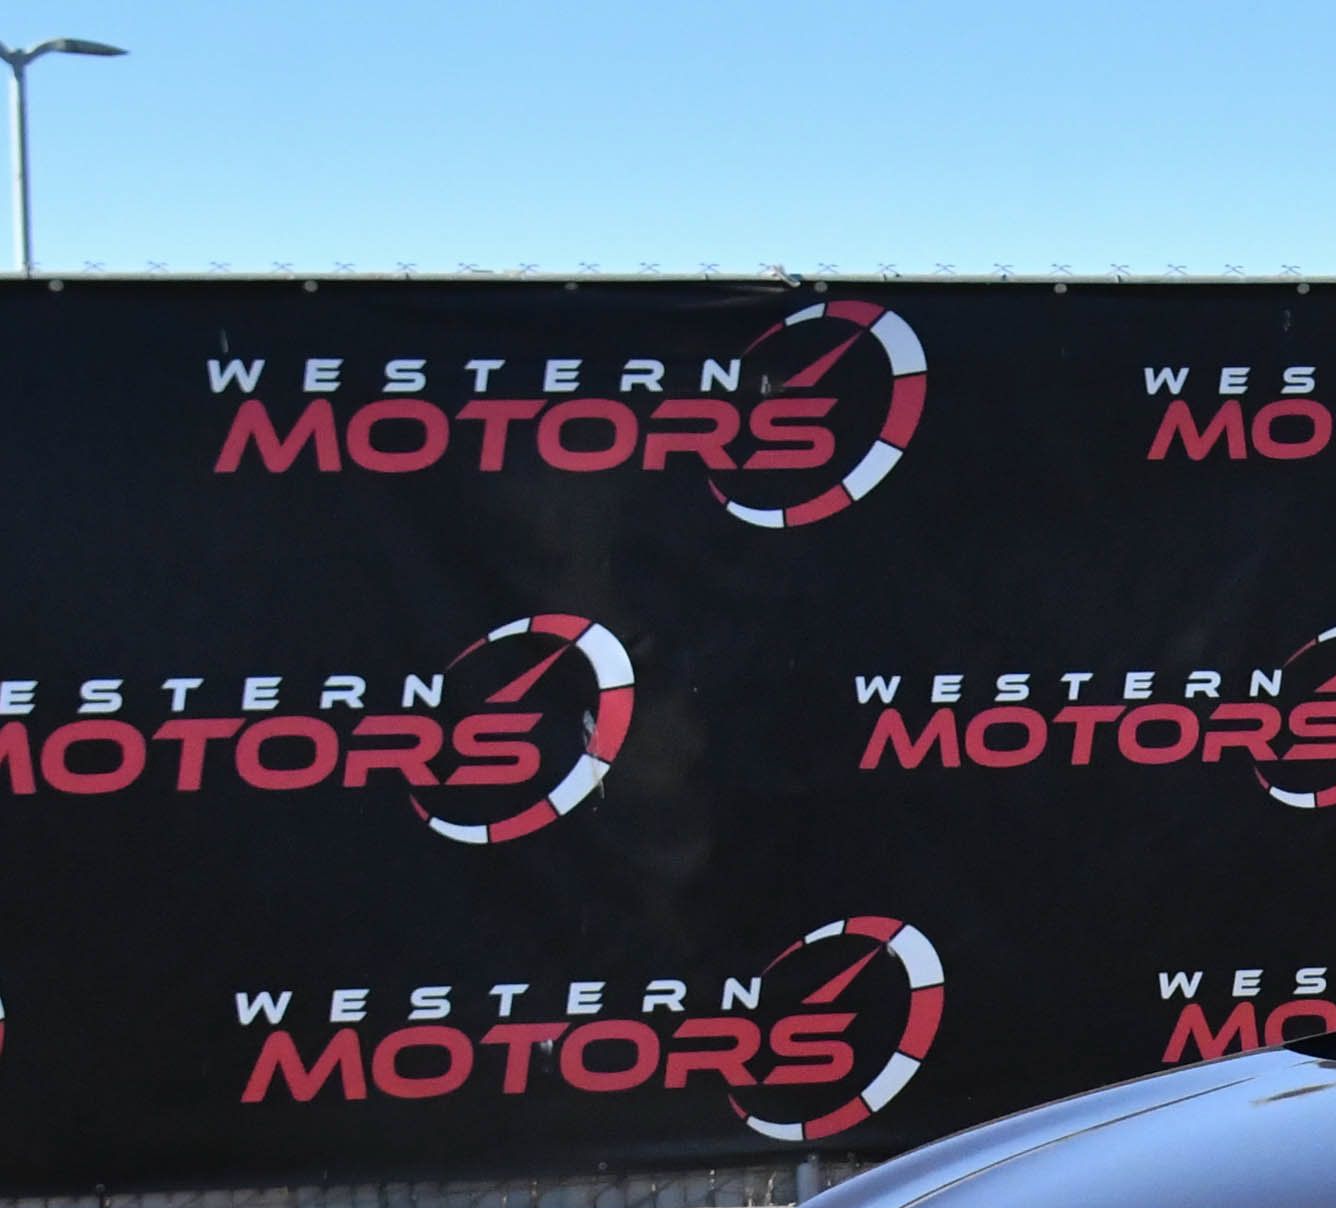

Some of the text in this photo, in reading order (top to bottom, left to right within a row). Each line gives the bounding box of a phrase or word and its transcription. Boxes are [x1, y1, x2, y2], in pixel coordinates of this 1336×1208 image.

[207, 358, 742, 393] WESTERN
[214, 398, 839, 474] MOTORS
[855, 669, 1283, 705] WESTERN
[236, 977, 762, 1026] WESTERN
[241, 1012, 859, 1104] MOTORS
